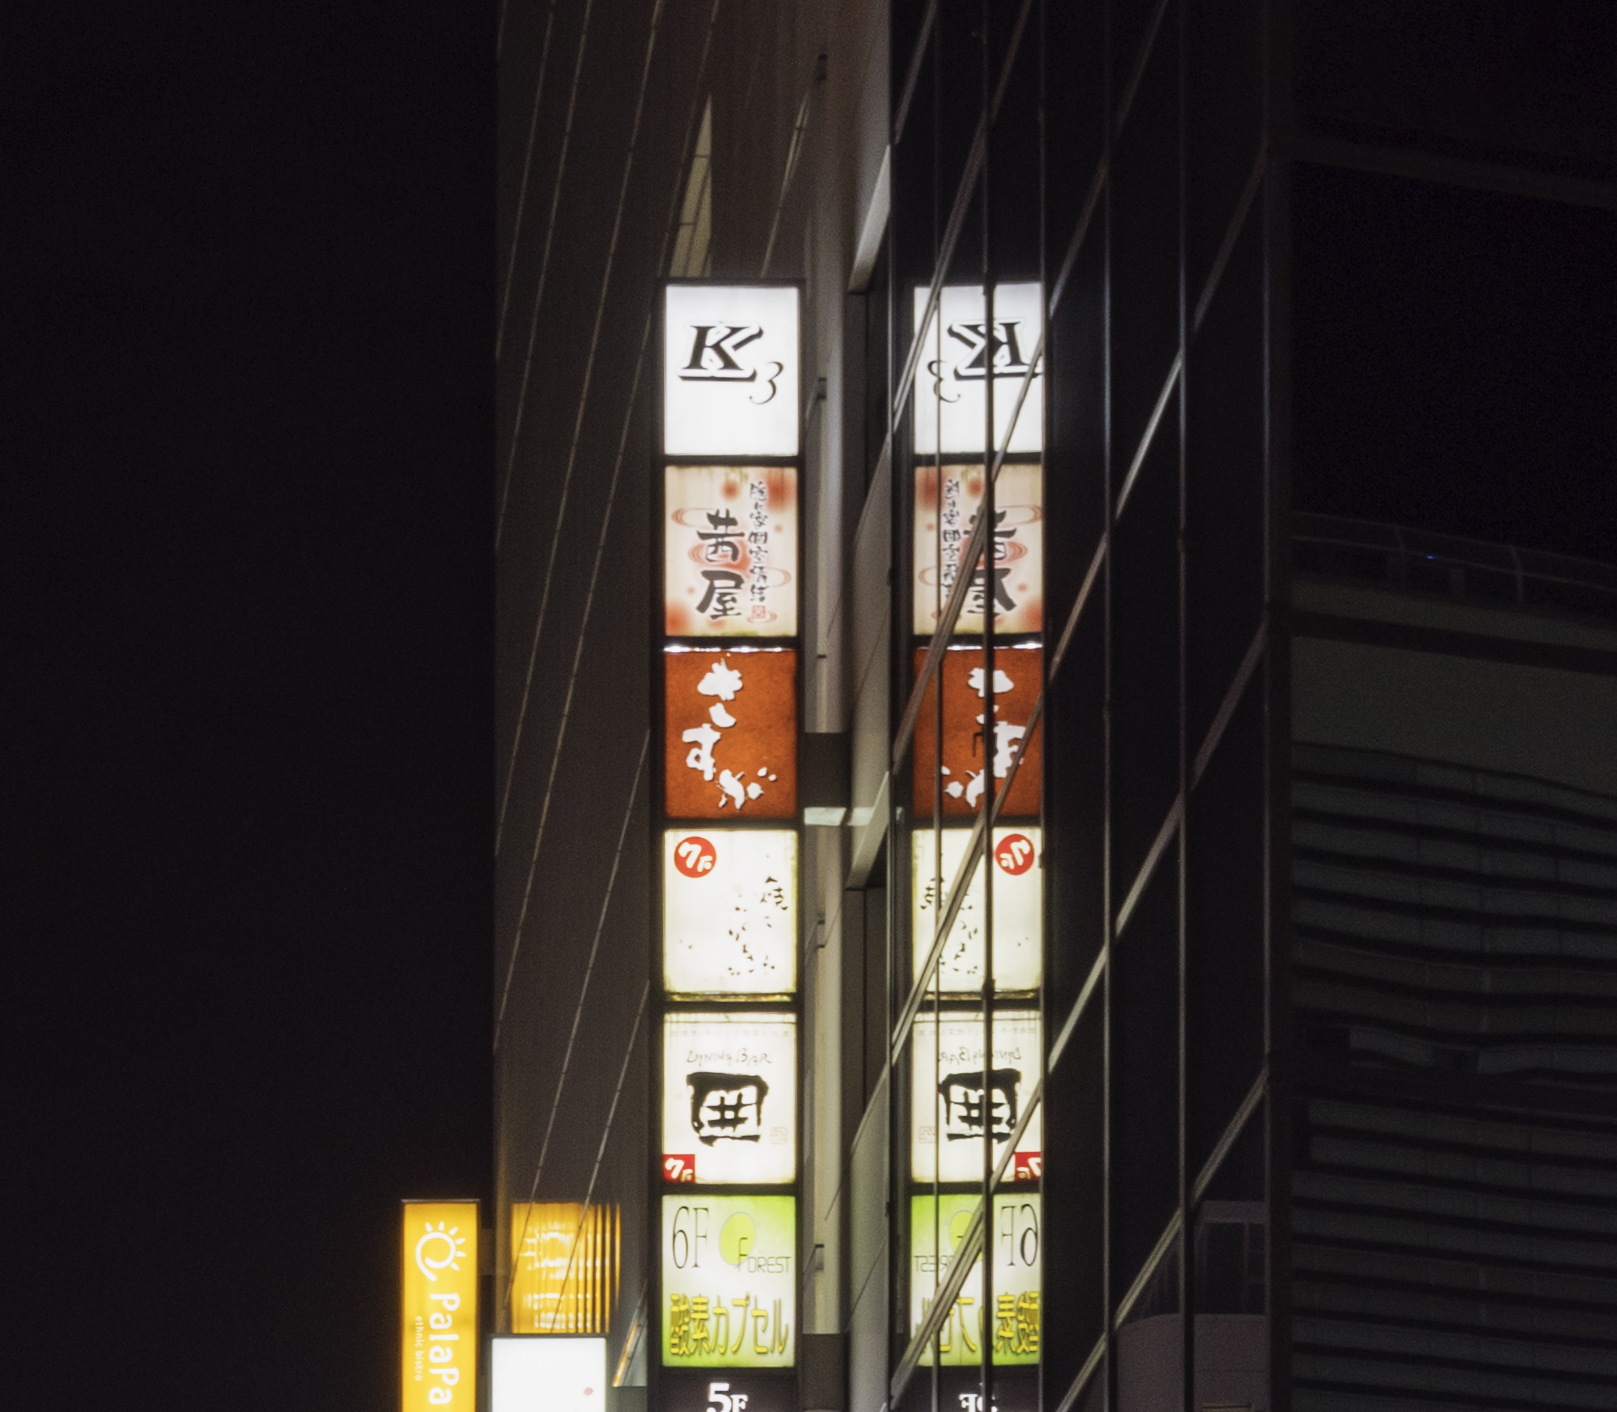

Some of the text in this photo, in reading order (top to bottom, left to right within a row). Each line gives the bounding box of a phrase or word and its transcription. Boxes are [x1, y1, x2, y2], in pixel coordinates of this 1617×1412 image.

[696, 508, 745, 620] 茜屋
[672, 1205, 710, 1269] 6F
[670, 1291, 789, 1357] 酸素カプセル
